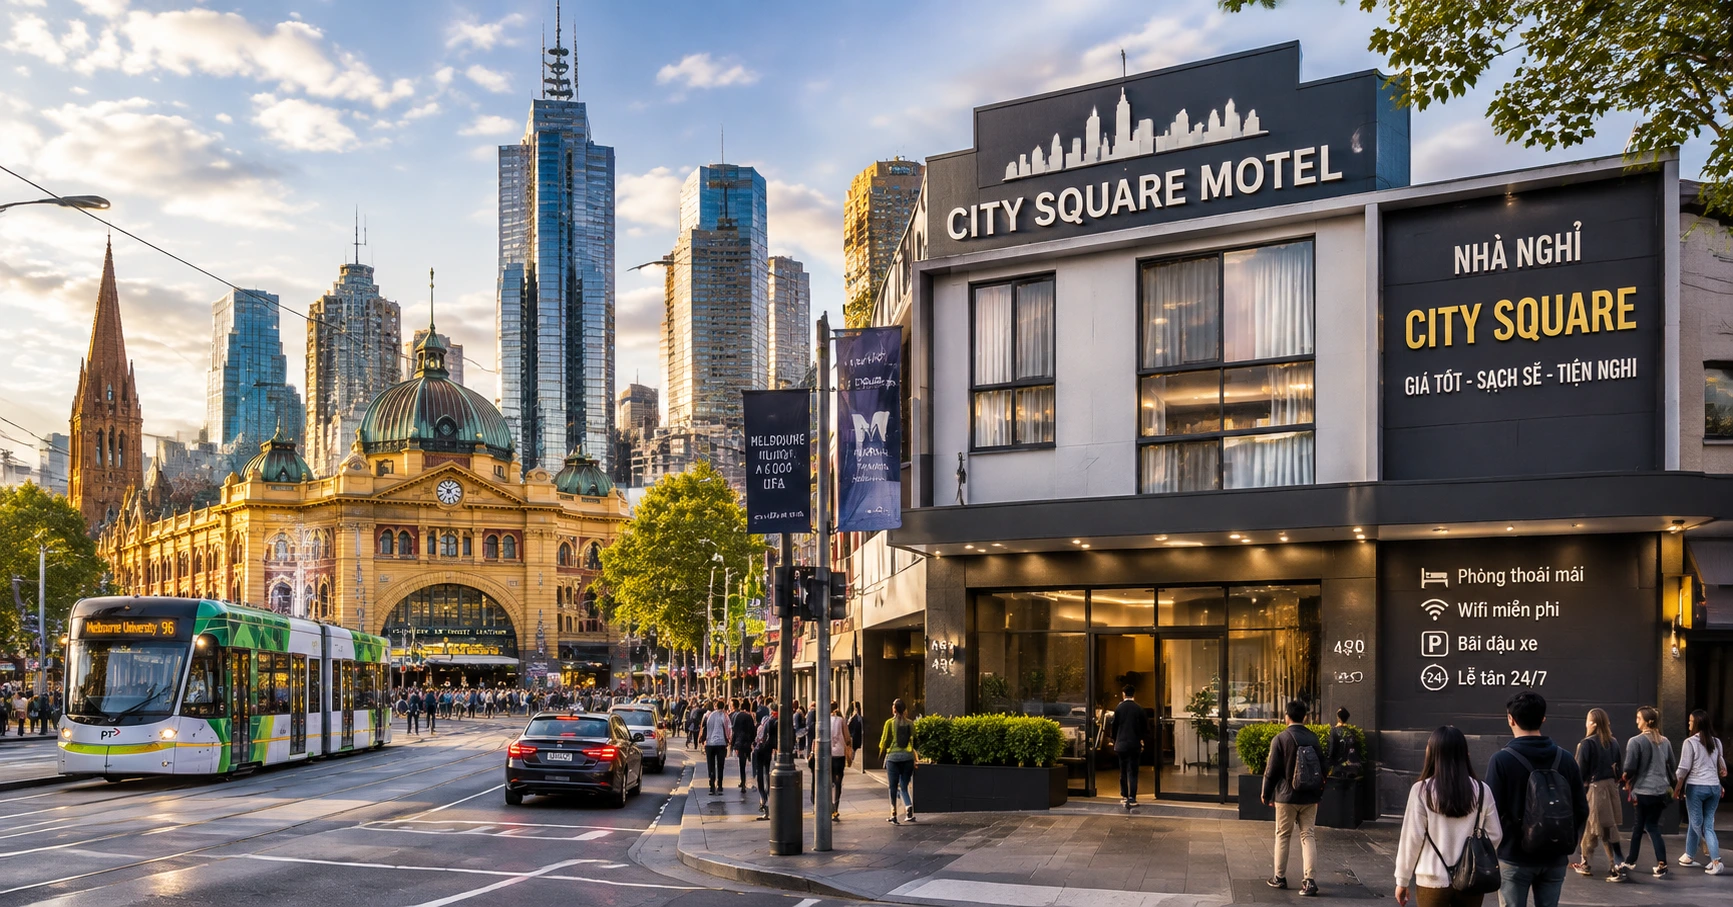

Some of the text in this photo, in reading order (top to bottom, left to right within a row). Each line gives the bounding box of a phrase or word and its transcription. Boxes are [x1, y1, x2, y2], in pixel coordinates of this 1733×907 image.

[947, 144, 1343, 240] CITY SQUARE MOTEL
[1454, 220, 1582, 275] NHÀ NGHỈ
[1405, 286, 1637, 349] CITY SQUARE
[1404, 371, 1430, 396] GIÁ
[1433, 368, 1463, 394] TỐT
[1597, 357, 1637, 380] NGHI
[1458, 567, 1506, 587] Phòng
[1457, 601, 1488, 618] Wifi
[1535, 600, 1560, 621] phi
[161, 621, 174, 635] 96
[1519, 638, 1538, 652] xe
[1510, 669, 1548, 689] 24/7
